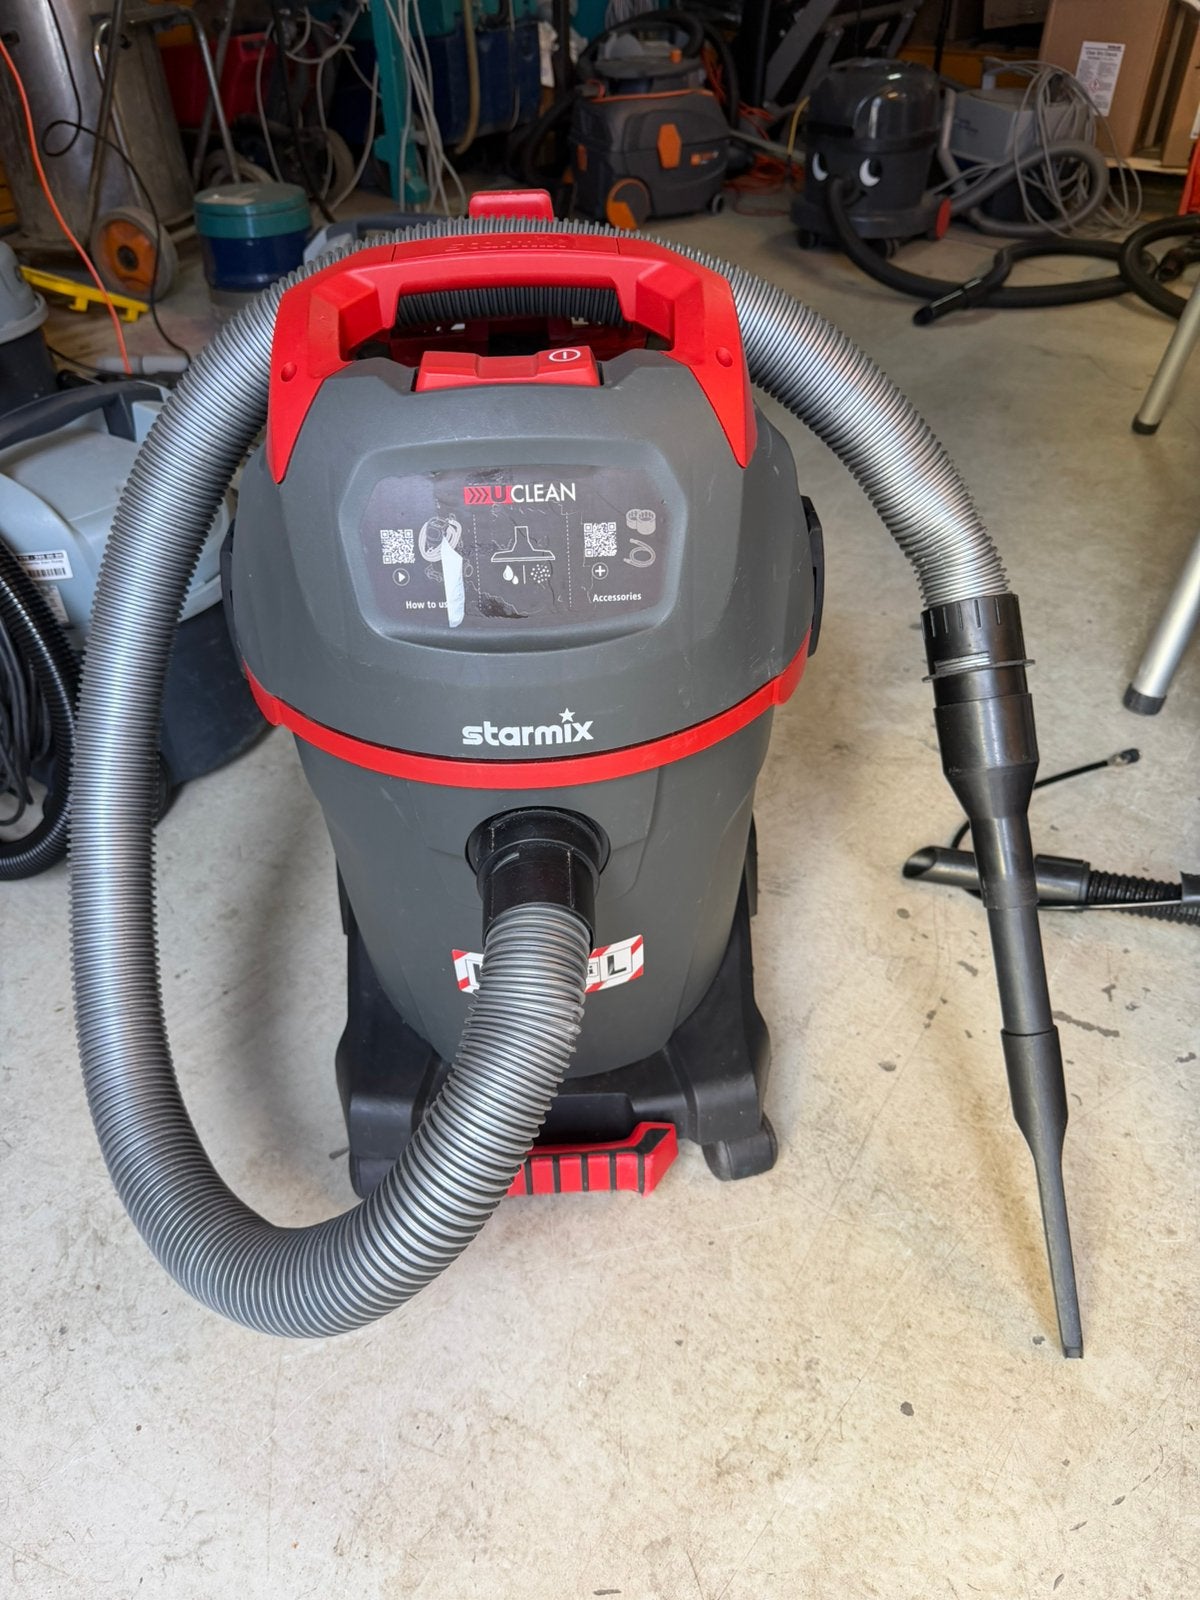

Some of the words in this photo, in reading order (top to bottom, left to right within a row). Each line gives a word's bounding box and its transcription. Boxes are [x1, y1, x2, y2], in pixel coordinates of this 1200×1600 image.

[490, 482, 577, 504] UCLEAN
[405, 600, 425, 609] How
[427, 600, 436, 609] to
[438, 601, 449, 609] us
[592, 592, 642, 603] Accessories
[462, 709, 594, 746] starmix
[607, 955, 627, 976] L
